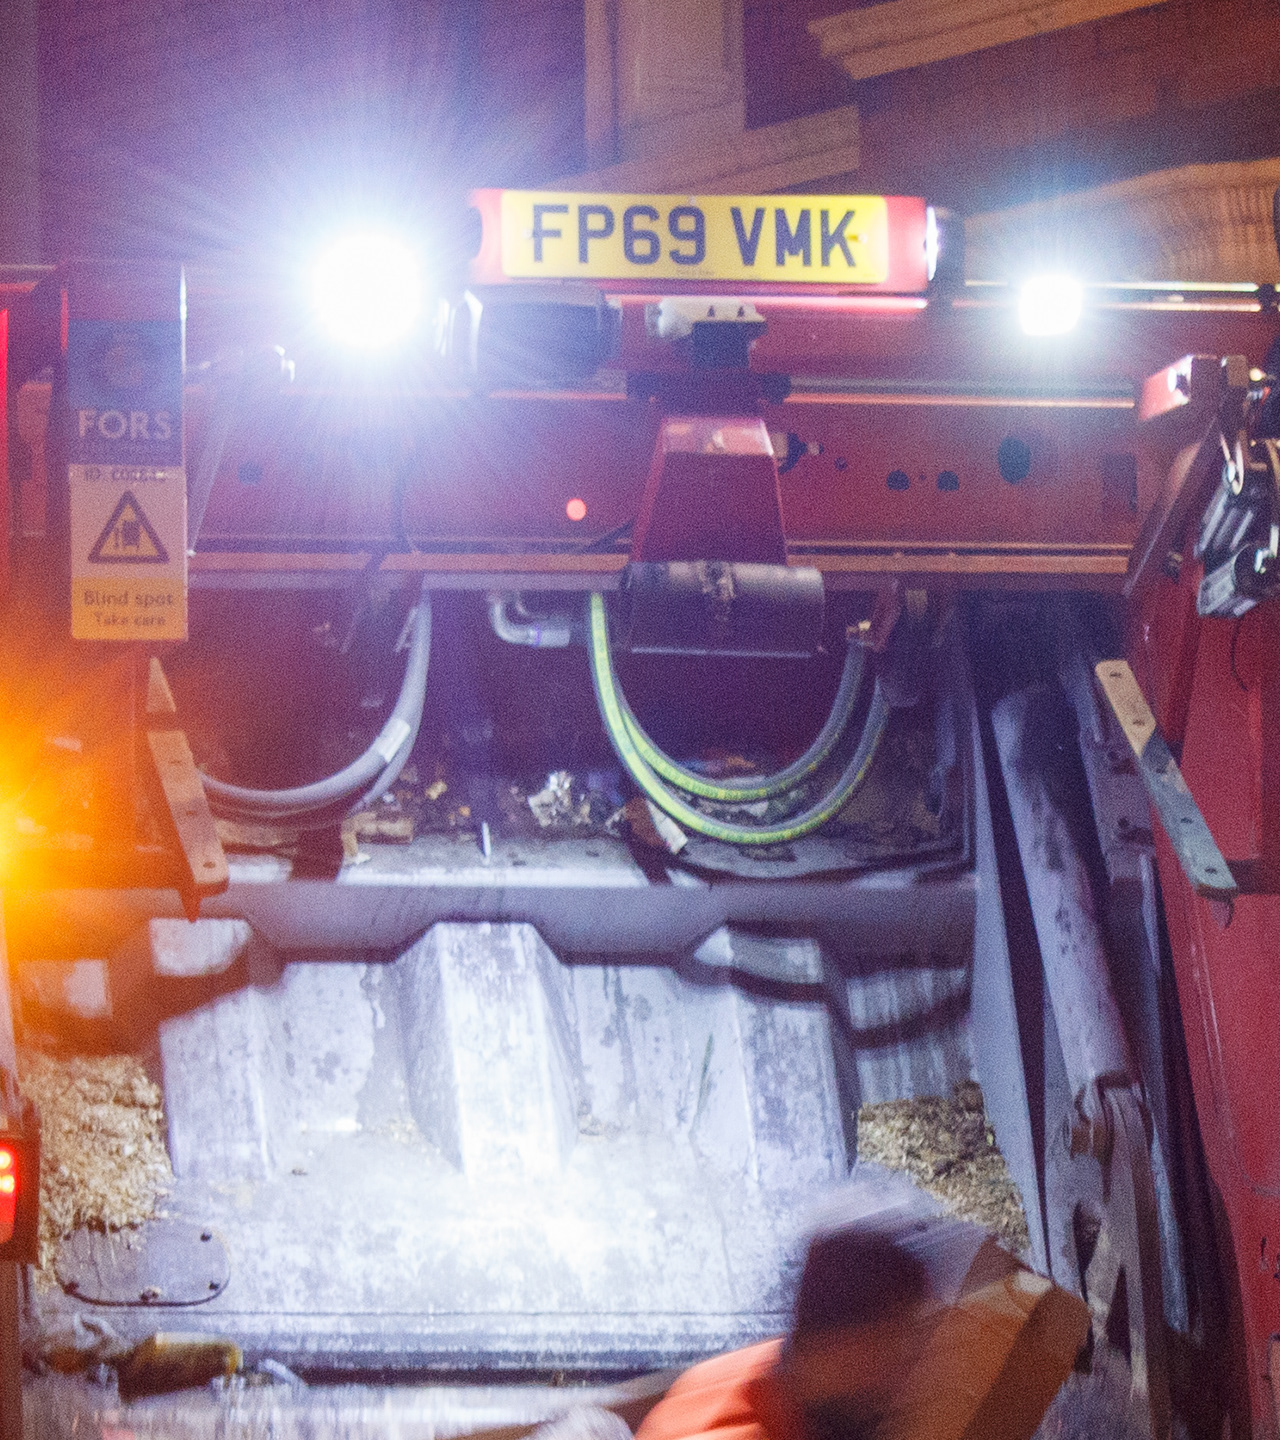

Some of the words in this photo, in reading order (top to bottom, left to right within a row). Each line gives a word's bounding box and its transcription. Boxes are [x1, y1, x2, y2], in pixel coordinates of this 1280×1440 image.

[531, 203, 707, 266] FP69
[729, 206, 858, 268] VMK
[77, 409, 173, 440] FORS
[83, 588, 130, 606] Blind
[134, 592, 174, 609] spot
[93, 610, 129, 627] Take
[133, 616, 166, 628] care
